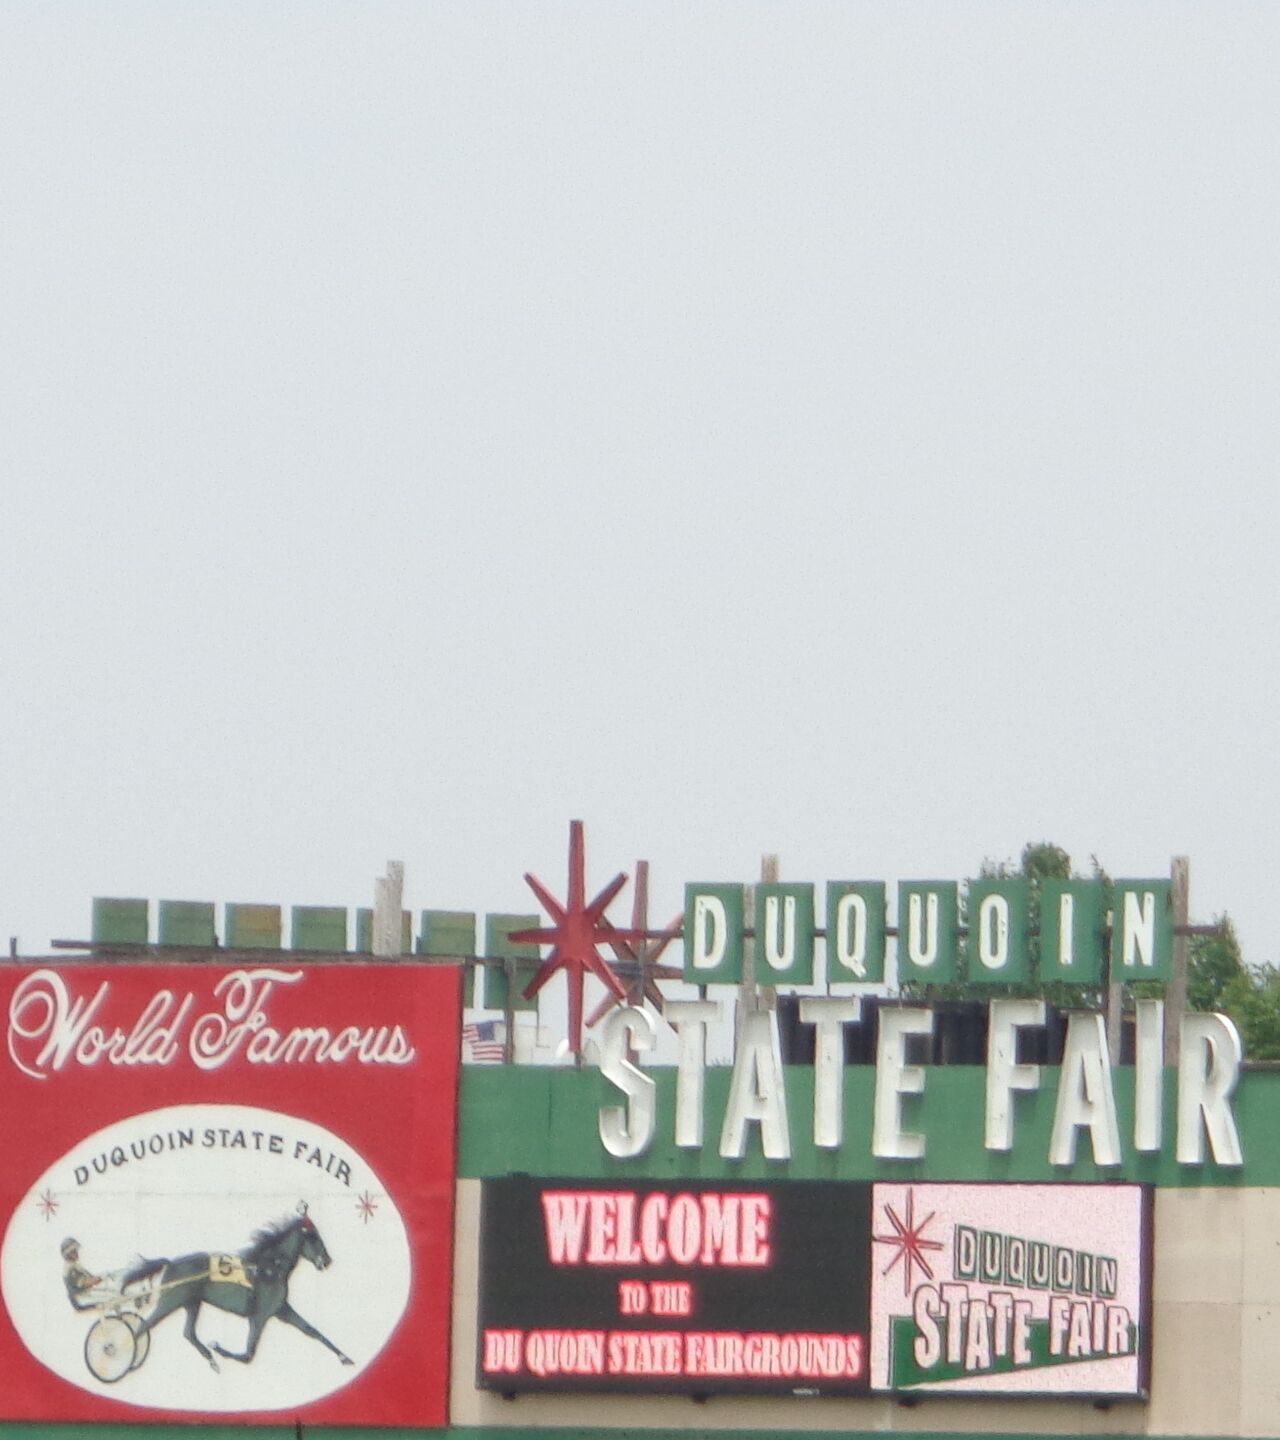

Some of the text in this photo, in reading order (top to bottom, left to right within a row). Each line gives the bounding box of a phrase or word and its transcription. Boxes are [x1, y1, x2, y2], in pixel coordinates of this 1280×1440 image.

[693, 891, 1154, 978] DUQUOIN
[7, 968, 416, 1079] World Famous
[599, 999, 1244, 1166] STATE FAIR
[74, 1128, 352, 1187] DUQUOIN STATE FAIR
[542, 1191, 772, 1266] WELCOME
[957, 1227, 1117, 1295] DUQUOIN
[218, 1255, 234, 1277] 5
[620, 1281, 692, 1315] TO THE
[483, 1329, 863, 1377] DU QUOIN STATE FAIRGROUNDS
[913, 1282, 1131, 1371] STATE FAIR
